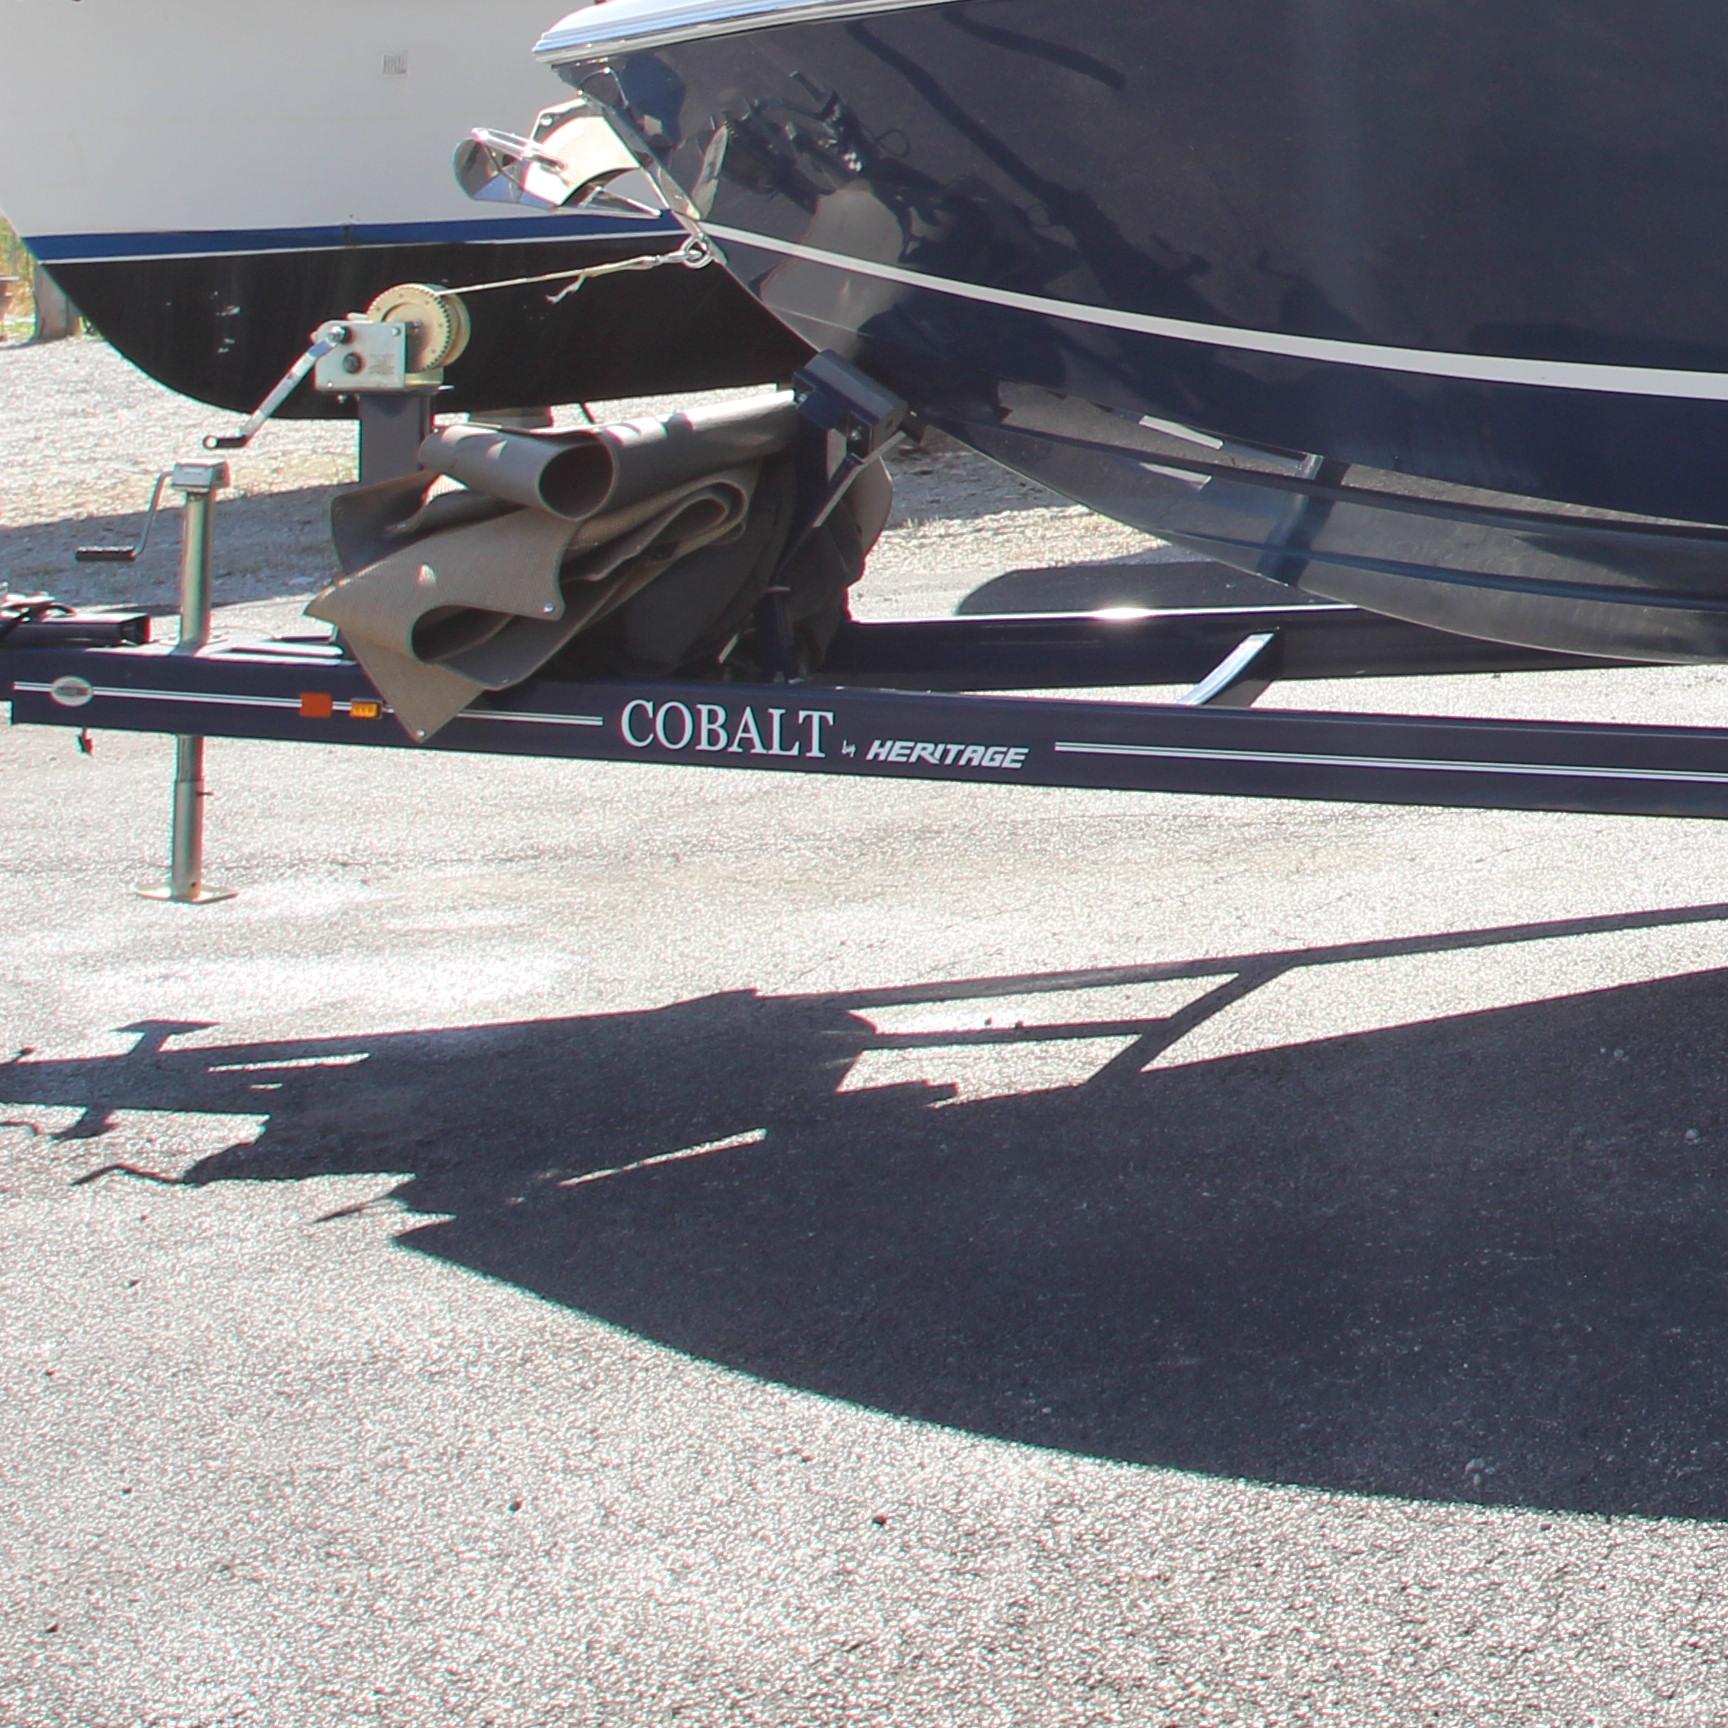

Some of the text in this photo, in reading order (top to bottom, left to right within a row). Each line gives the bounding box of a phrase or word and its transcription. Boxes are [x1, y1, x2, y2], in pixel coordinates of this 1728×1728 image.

[620, 699, 1030, 769] COBALT by HERITAGE
